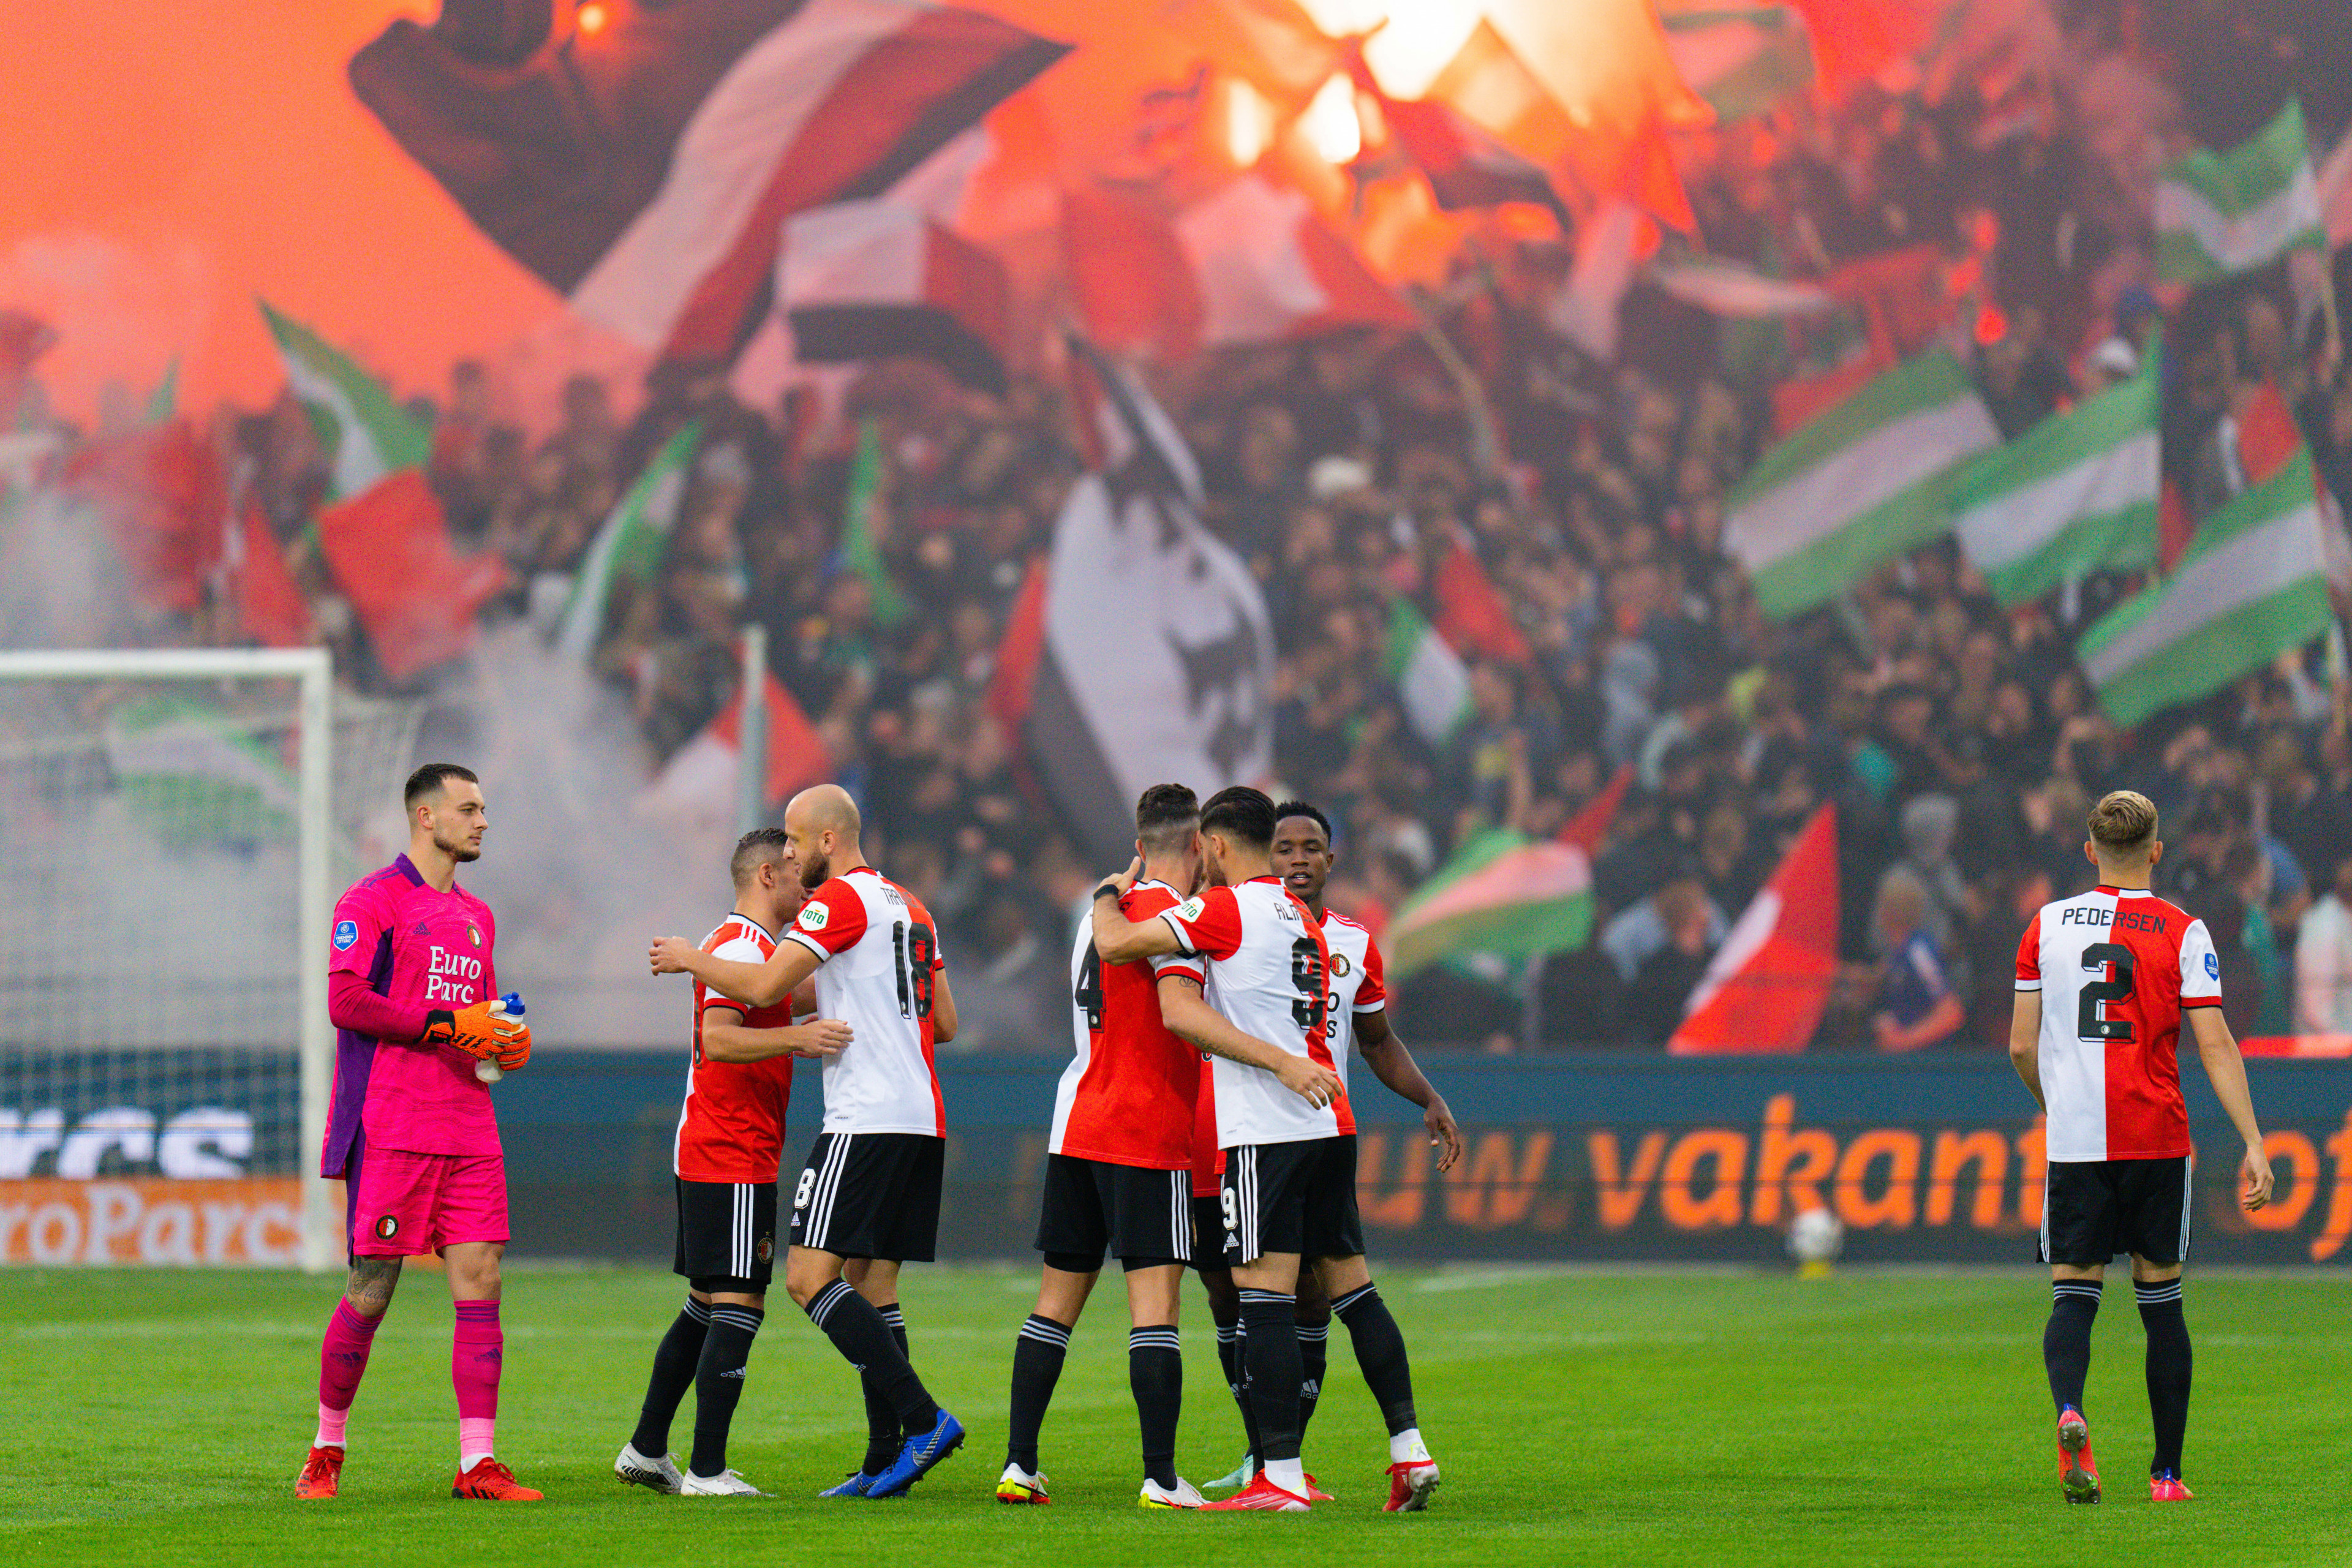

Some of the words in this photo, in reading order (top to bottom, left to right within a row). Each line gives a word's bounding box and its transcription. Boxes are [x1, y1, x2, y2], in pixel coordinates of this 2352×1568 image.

[802, 909, 825, 925] TOTO
[1181, 902, 1198, 918] OTO
[2062, 907, 2166, 935] PEDERSEN
[429, 946, 481, 980] Euro
[892, 921, 936, 1022] 18
[425, 974, 475, 1004] Parc
[1074, 935, 1107, 1033] 4
[1291, 937, 1327, 1031] 9
[2078, 943, 2138, 1043] 2
[1223, 1187, 1238, 1231] 9
